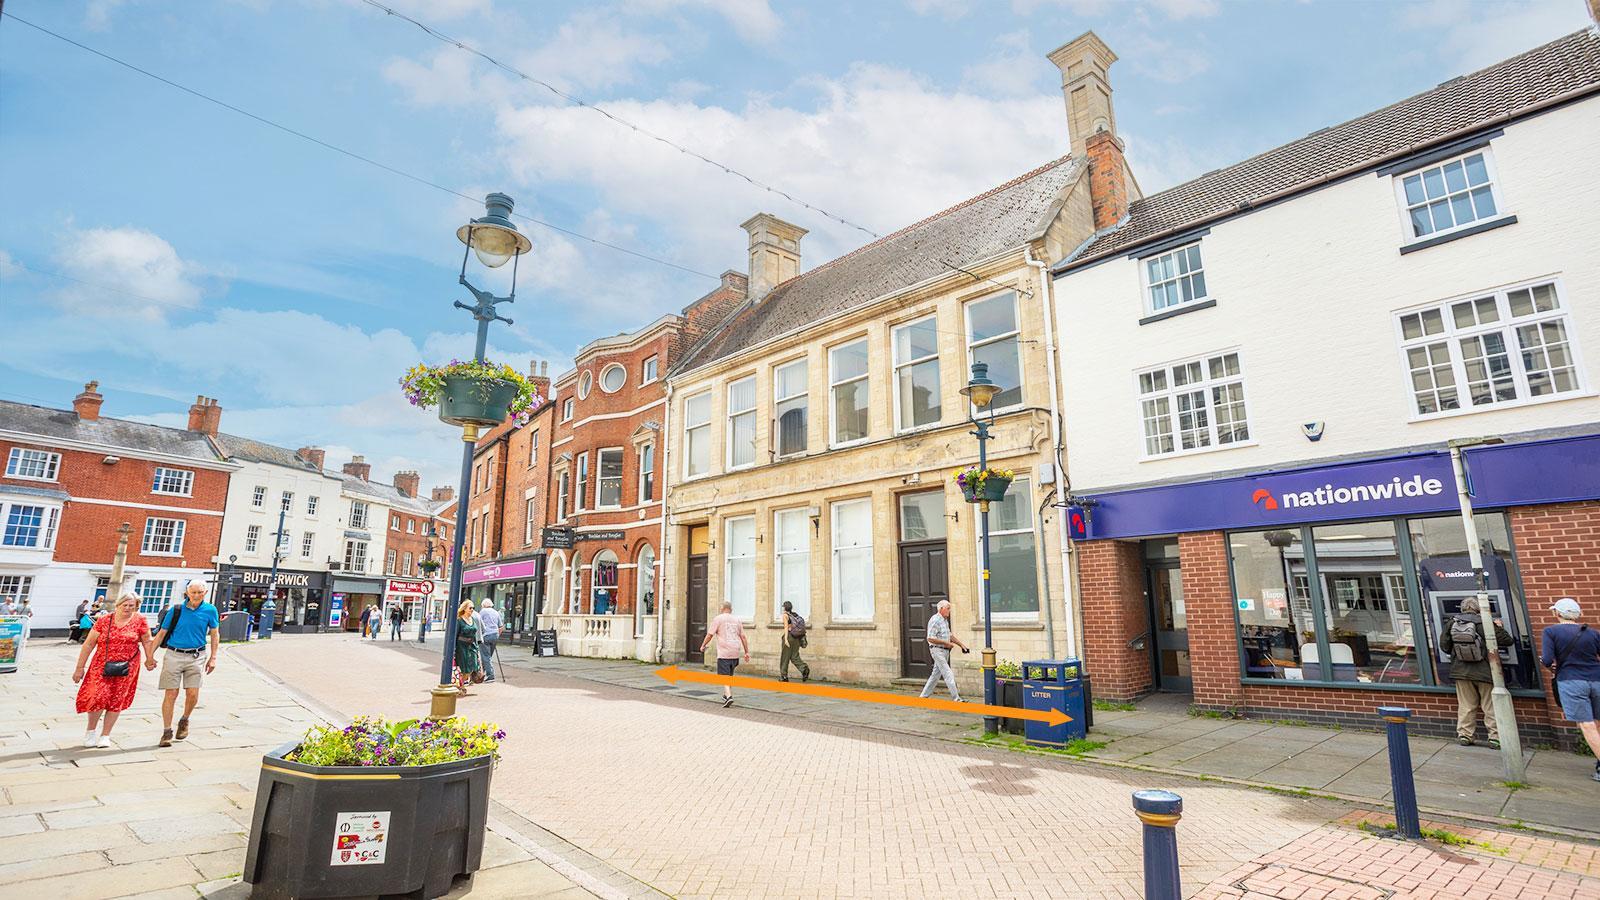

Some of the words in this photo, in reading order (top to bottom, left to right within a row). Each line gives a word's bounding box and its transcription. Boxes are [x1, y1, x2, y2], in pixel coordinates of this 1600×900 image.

[1282, 475, 1443, 509] nationwide
[1263, 591, 1285, 600] Happy
[1031, 691, 1051, 699] LITTER
